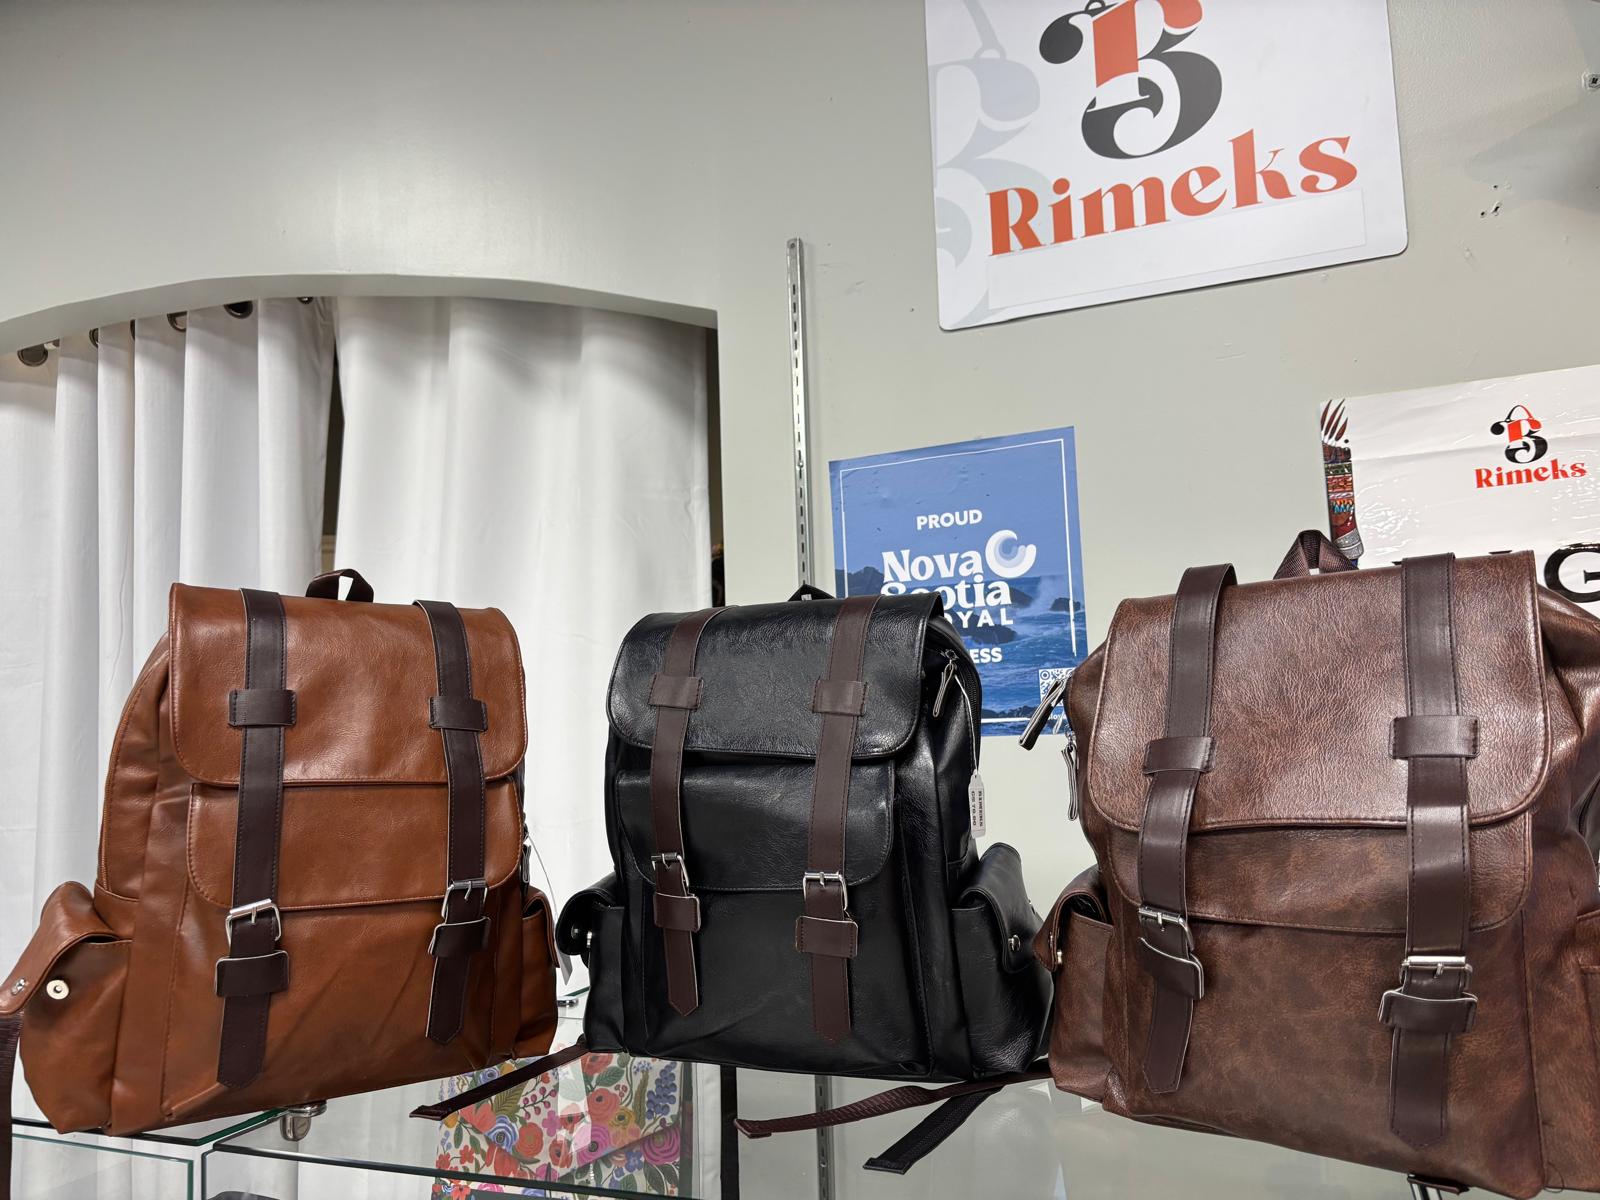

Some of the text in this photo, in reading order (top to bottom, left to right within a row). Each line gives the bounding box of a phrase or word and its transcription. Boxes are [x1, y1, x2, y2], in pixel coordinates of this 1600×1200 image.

[986, 129, 1358, 257] Rimeks
[1475, 458, 1588, 489] Rimeks
[916, 509, 983, 531] PROUD
[881, 549, 984, 583] Nova
